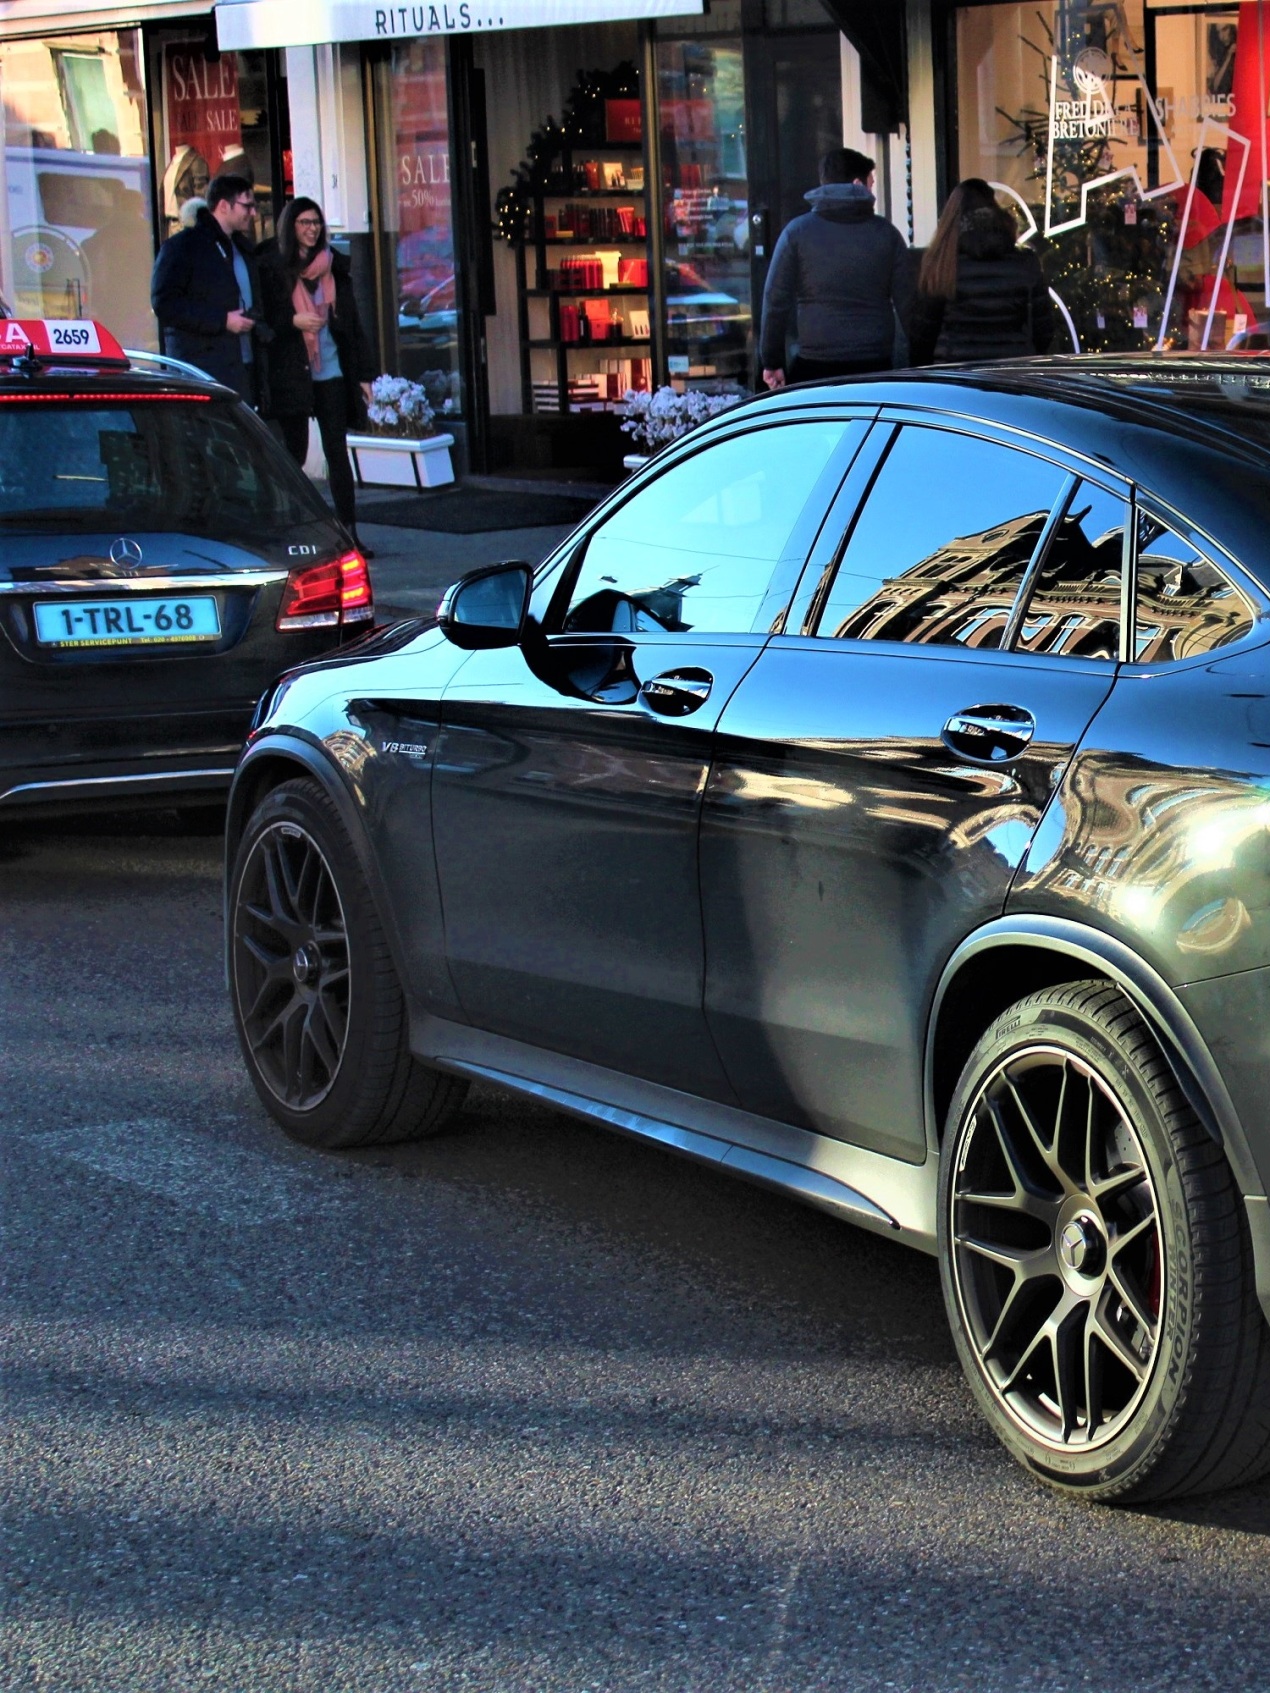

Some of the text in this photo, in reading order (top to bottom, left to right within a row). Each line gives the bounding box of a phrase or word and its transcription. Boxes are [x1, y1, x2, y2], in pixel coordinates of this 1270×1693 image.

[375, 3, 504, 35] RITUALS...
[173, 51, 237, 101] SALE
[207, 109, 238, 132] SALE
[1055, 101, 1089, 120] FRED
[0, 322, 90, 345] A 2659
[288, 545, 317, 556] CDI
[61, 603, 194, 636] 1-TRL-68
[81, 637, 132, 647] SERVICEPUNT
[381, 741, 400, 753] V8
[995, 1015, 1022, 1040] PIRELLI
[1168, 1201, 1189, 1385] SCORPION
